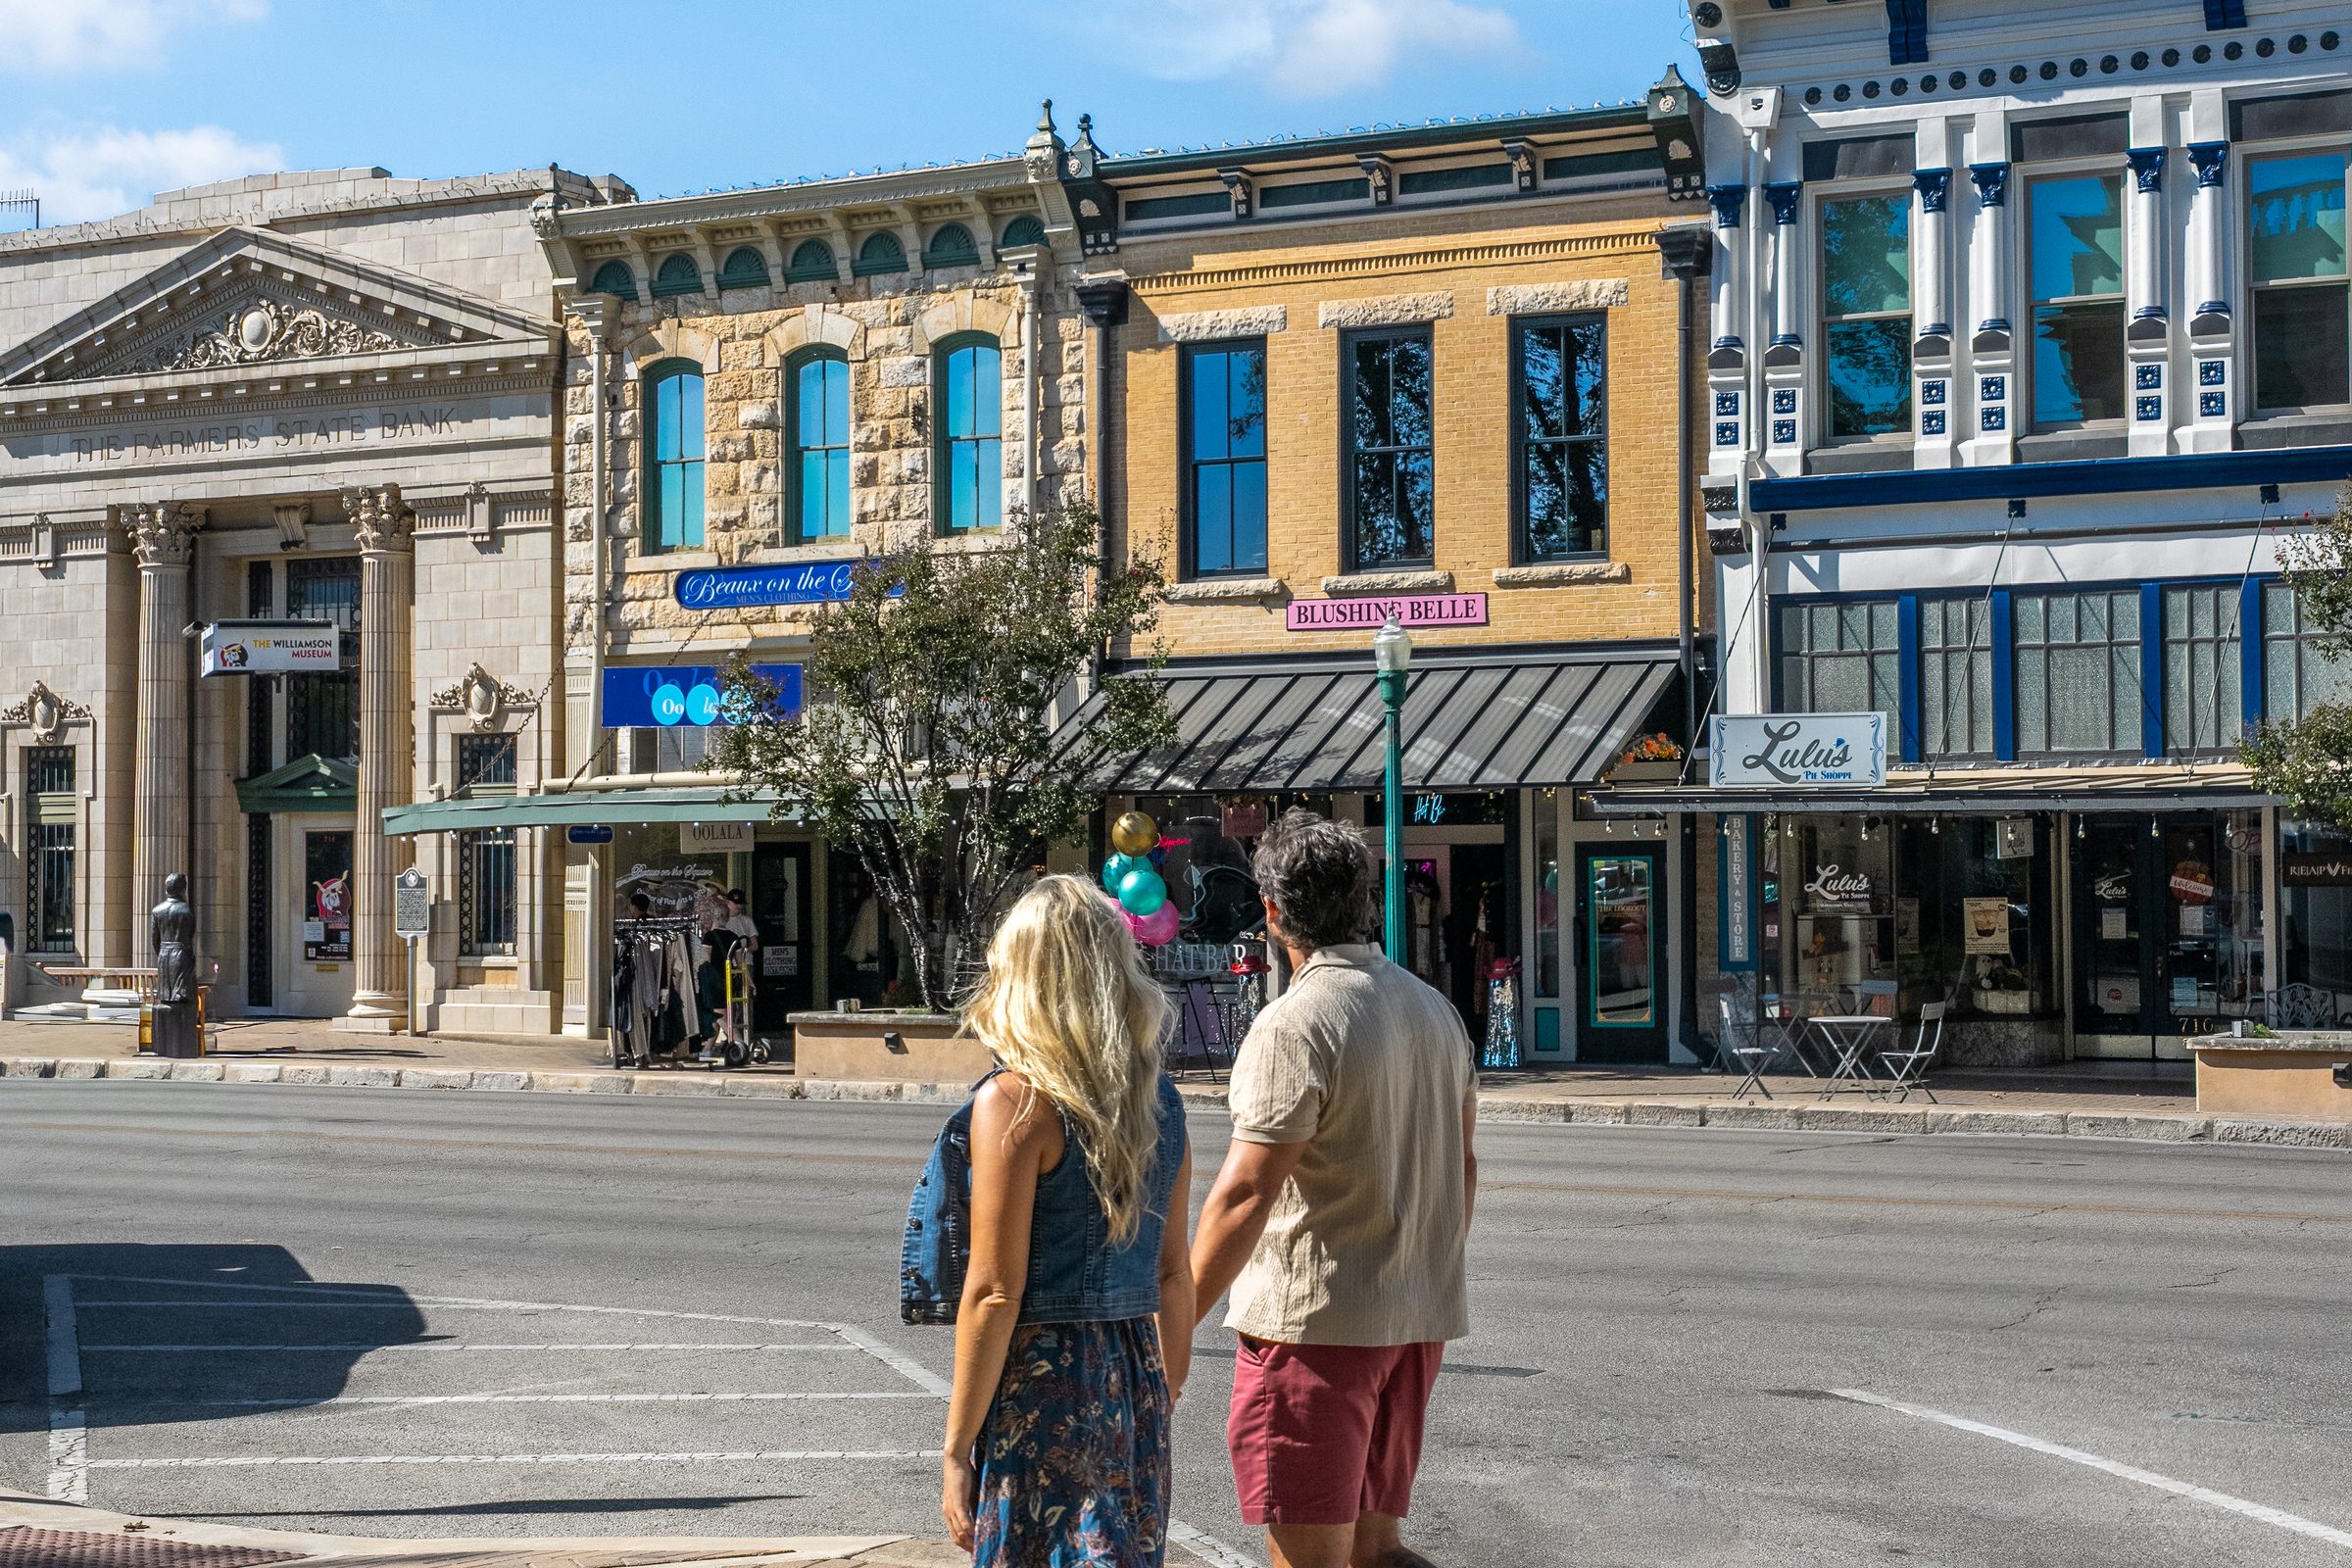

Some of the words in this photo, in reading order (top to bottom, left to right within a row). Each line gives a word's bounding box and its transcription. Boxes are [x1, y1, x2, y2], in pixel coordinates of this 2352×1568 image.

[71, 434, 122, 464] THE
[275, 416, 367, 447] STATE
[381, 408, 455, 440] BANK
[684, 571, 762, 603] Beaux
[766, 576, 791, 592] on
[797, 566, 826, 591] the
[763, 592, 810, 604] CLOTHING
[1296, 602, 1404, 624] BLUSHING
[1409, 599, 1478, 620] BELLE
[253, 640, 271, 649] THE
[273, 639, 332, 649] WILLIAMSON
[291, 650, 332, 659] MUSEUM
[662, 698, 684, 715] Oo
[1741, 720, 1853, 784] Lulu's
[693, 824, 744, 841] OOLALA
[1732, 817, 1742, 885] BAKERY
[1804, 863, 1870, 901] Lulu's
[1733, 902, 1743, 957] STORE
[1154, 944, 1200, 972] HAT
[2179, 1017, 2214, 1033] 710
